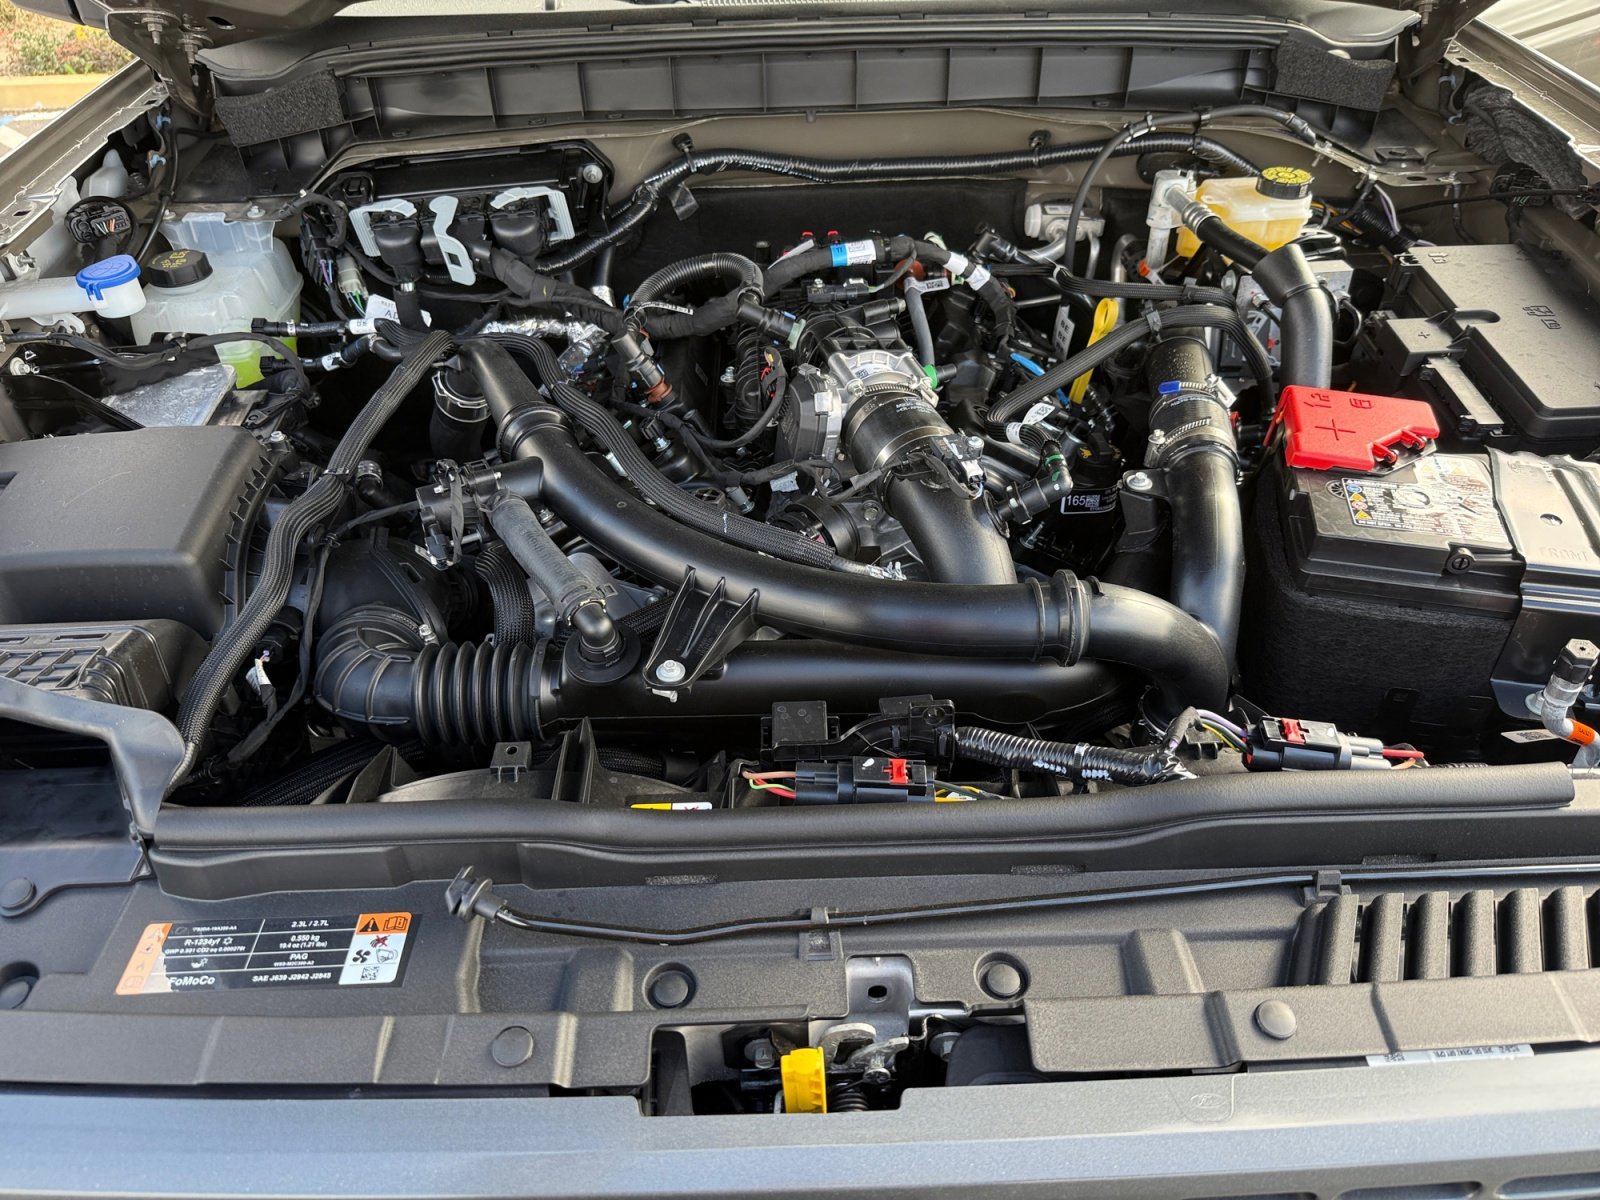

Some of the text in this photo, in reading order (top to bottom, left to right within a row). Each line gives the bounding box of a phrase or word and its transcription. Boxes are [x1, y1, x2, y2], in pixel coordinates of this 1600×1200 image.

[1066, 494, 1086, 506] 165
[291, 920, 308, 928] 2.3L
[313, 919, 329, 927] 2.7L
[170, 975, 216, 986] FoMoCo
